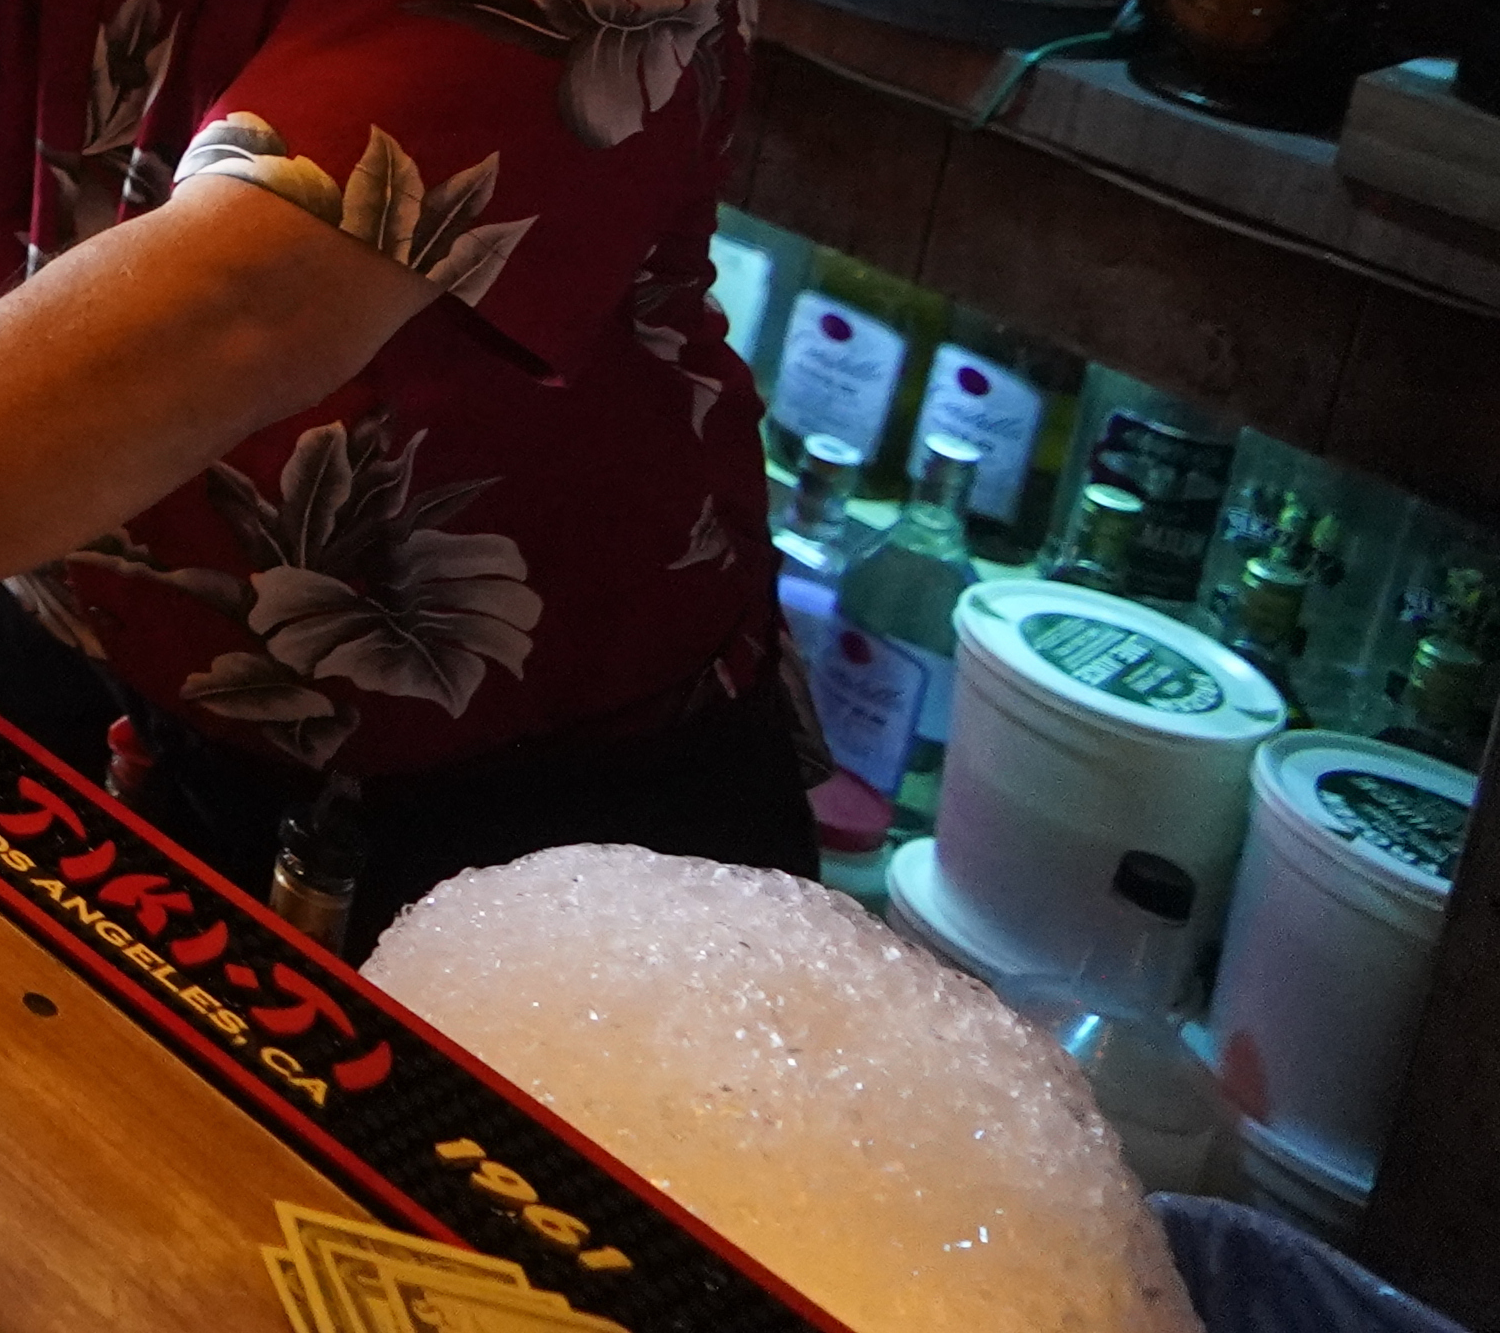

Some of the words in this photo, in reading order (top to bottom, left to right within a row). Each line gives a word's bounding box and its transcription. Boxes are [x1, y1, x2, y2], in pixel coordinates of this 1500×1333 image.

[30, 875, 249, 1047] ANGELES,
[258, 1044, 329, 1109] CA
[433, 1136, 634, 1272] 1961
